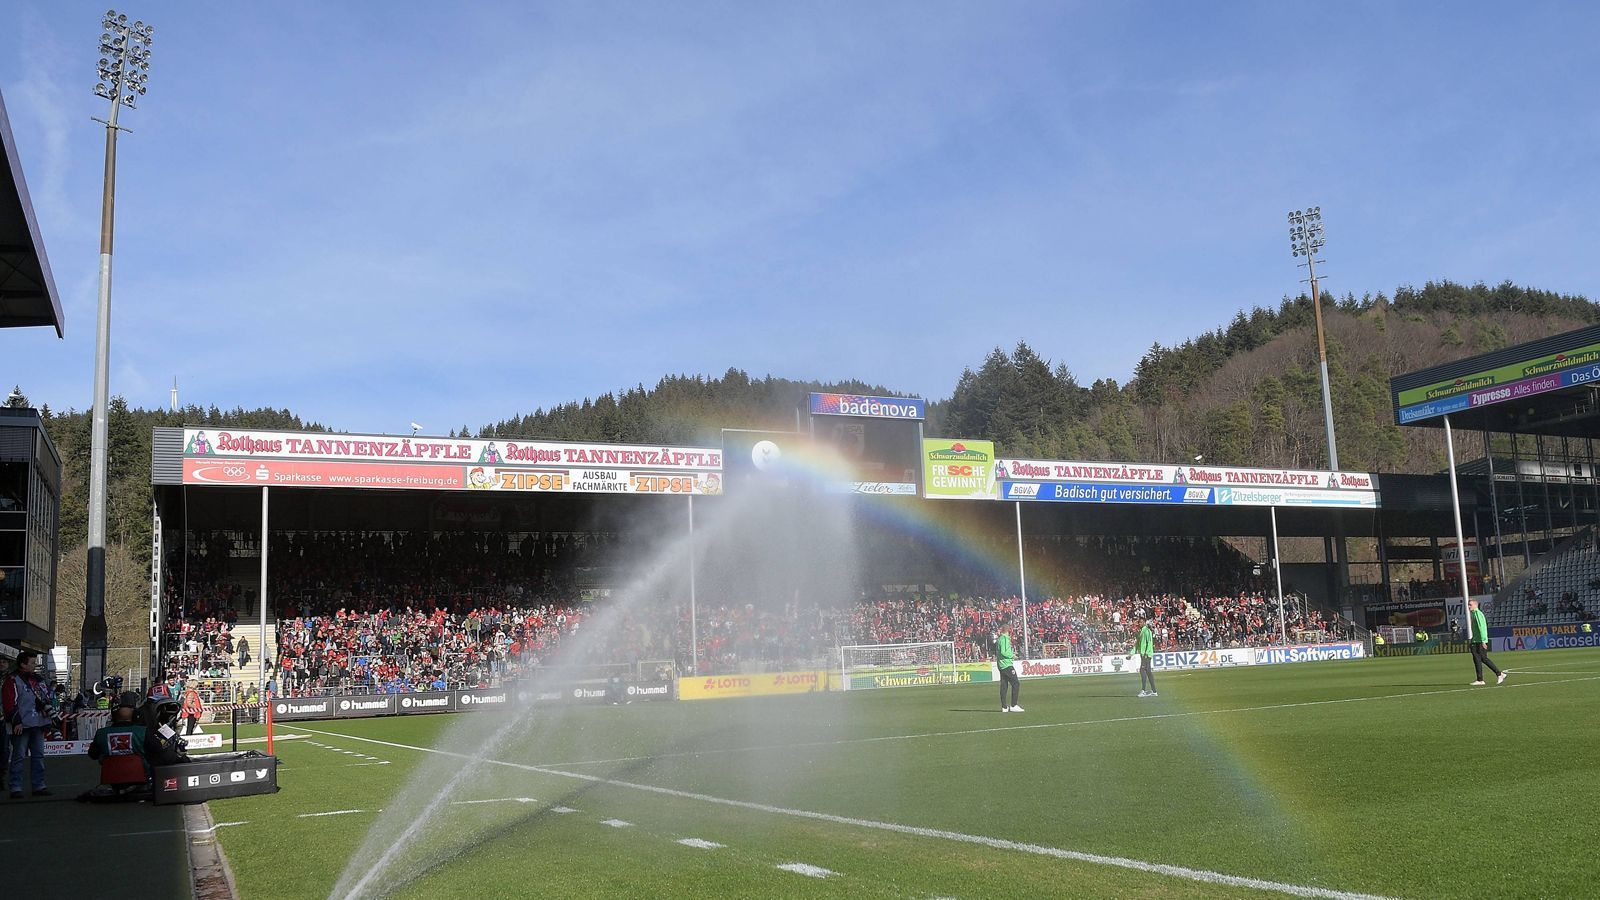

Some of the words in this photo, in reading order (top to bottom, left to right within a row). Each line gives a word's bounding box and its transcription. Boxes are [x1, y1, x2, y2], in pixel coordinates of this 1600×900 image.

[1524, 351, 1599, 376] Schwarzwaldmilch
[1571, 372, 1590, 383] Das
[1427, 377, 1492, 399] Schwarzwaldmilch
[1472, 387, 1511, 405] Zypresse
[1514, 384, 1531, 396] Alles
[839, 397, 917, 417] badenova
[216, 432, 283, 454] Rothaus
[286, 438, 472, 460] TANNENZÄPFLE
[505, 442, 561, 464] Rothaus
[564, 448, 721, 467] TANNENZÄPFLE
[930, 452, 987, 462] Schwarzwaldmilch
[582, 471, 617, 481] AUSBAU
[932, 464, 986, 477] FRISCHE
[1011, 460, 1051, 478] Rothaus
[1054, 464, 1164, 481] TANNENZÄPFLE
[1188, 467, 1222, 483] Rothaus
[1225, 471, 1319, 486] TANNENZÄPFLE
[274, 472, 322, 482] Sparkasse
[329, 475, 458, 486] www.sparkasse-freiburg.de
[500, 473, 563, 490] ZIPSE
[572, 480, 628, 492] FACHMÄRKTE
[635, 476, 693, 493] ZIPSE
[932, 476, 986, 489] GEWINNT!
[1340, 473, 1370, 488] Rothaus
[1055, 484, 1098, 499] Badisch
[1100, 488, 1121, 502] gut
[1121, 486, 1173, 501] versichert.
[1232, 490, 1283, 505] Zitzelsberger
[1512, 626, 1548, 637] EUROPA
[1551, 624, 1577, 635] PARK
[1545, 632, 1600, 648] lactosef
[1270, 646, 1351, 663] IN-Software
[1375, 640, 1468, 657] Schwarzwaldmi
[1070, 656, 1103, 665] TANNEN
[1152, 650, 1233, 667] BENZ24.DE
[1021, 660, 1061, 676] Rothaus
[1071, 664, 1103, 674] ZÄPFLE
[718, 678, 750, 689] LOTTO
[786, 674, 818, 685] LOTTO
[583, 688, 606, 698] humm
[637, 685, 668, 695] hummel
[352, 698, 389, 710] hummel
[412, 696, 449, 707] hummel
[471, 693, 506, 704] hummel
[288, 702, 327, 714] hummel
